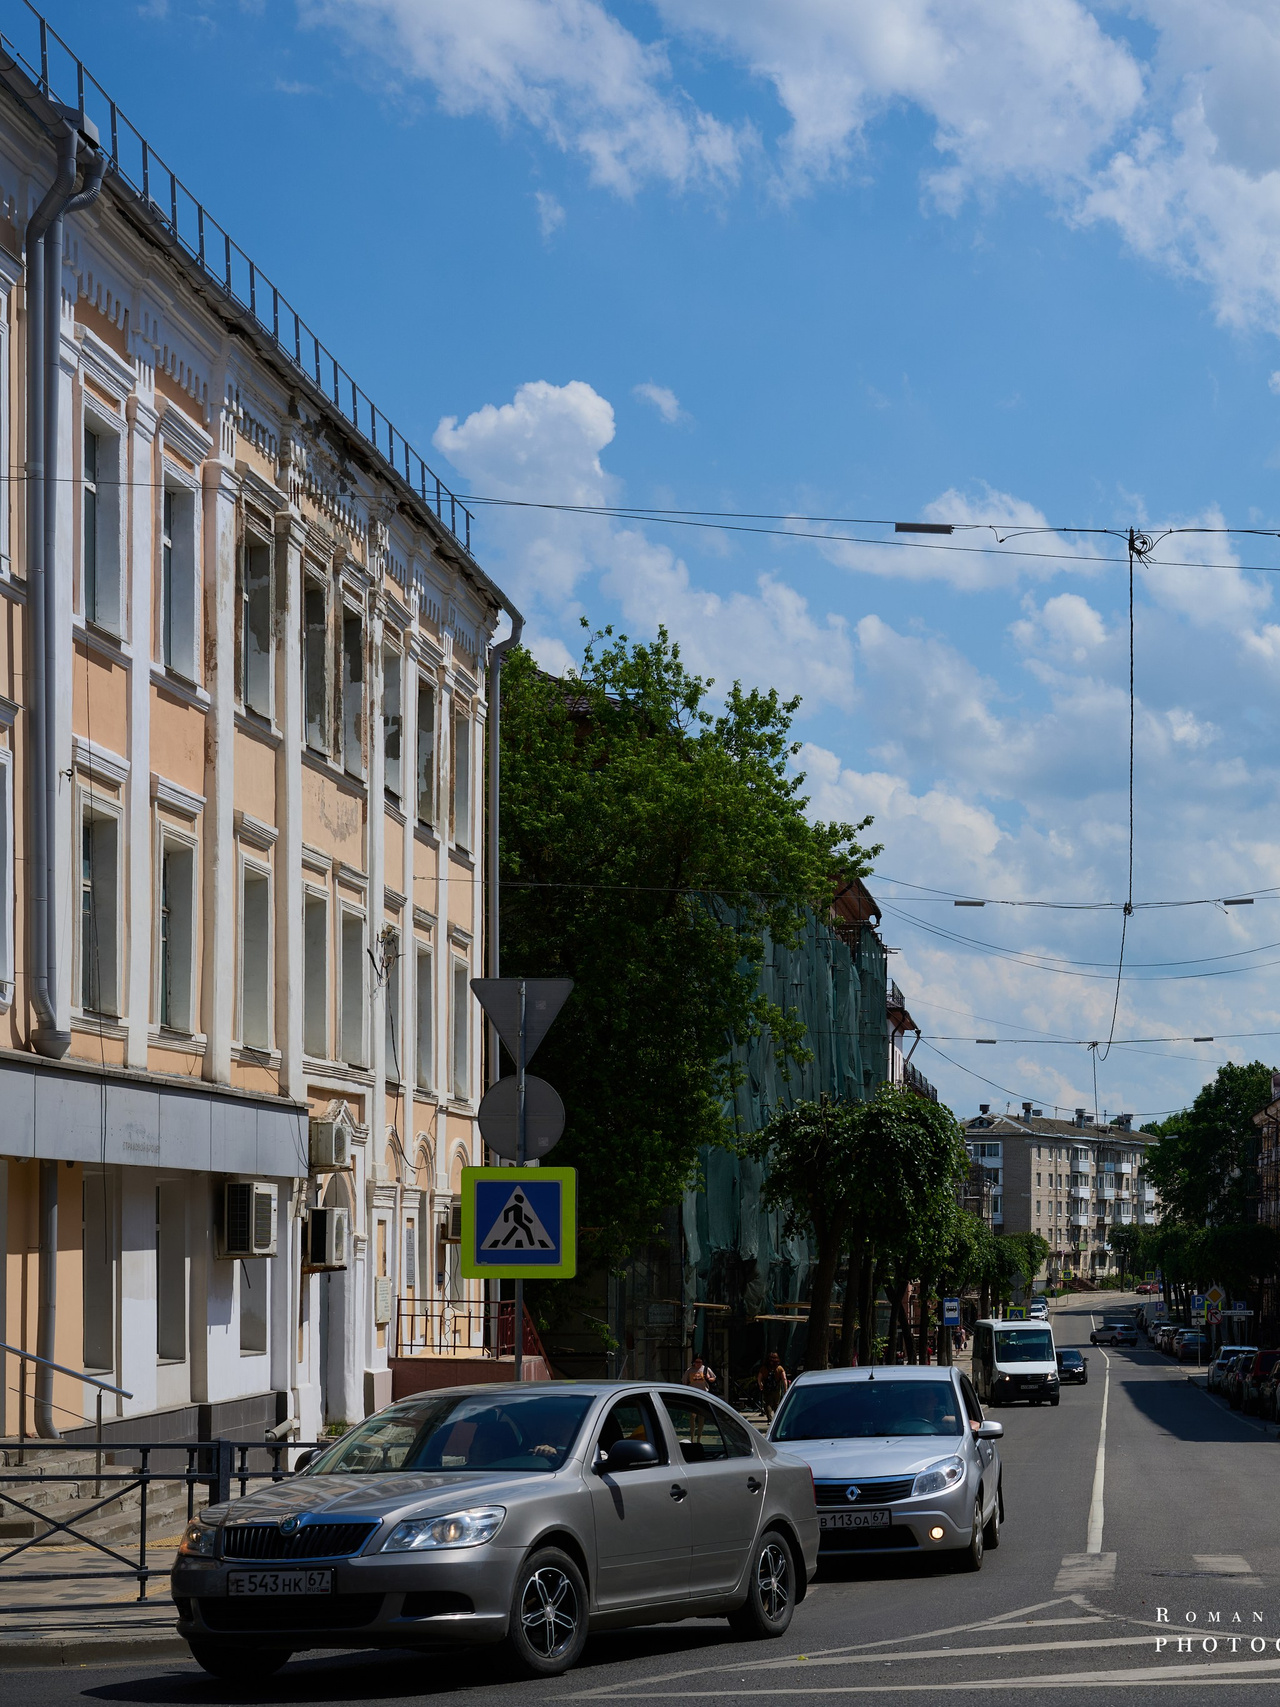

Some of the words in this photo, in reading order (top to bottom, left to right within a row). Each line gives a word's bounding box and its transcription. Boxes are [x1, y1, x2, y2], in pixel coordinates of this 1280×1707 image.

[1195, 1296, 1203, 1308] P
[872, 1512, 885, 1522] 67
[308, 1572, 325, 1587] 67
